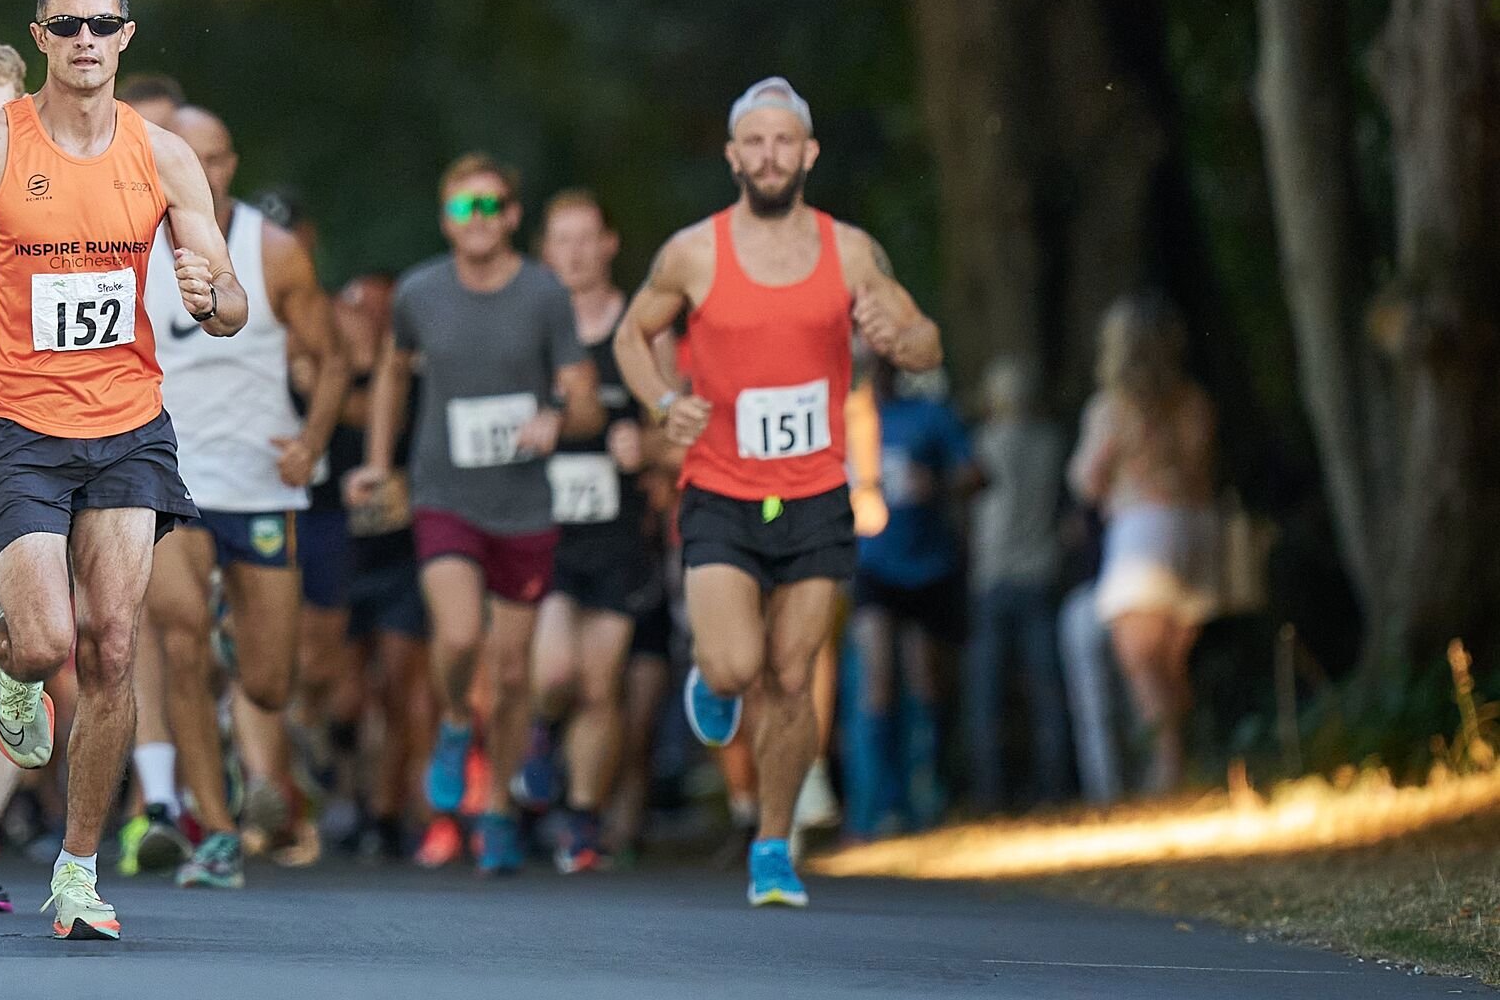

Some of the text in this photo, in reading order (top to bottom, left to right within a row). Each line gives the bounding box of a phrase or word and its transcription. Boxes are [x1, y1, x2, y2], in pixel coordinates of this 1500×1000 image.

[15, 241, 80, 256] INSPIRE
[57, 298, 121, 347] 152
[762, 412, 812, 453] 151
